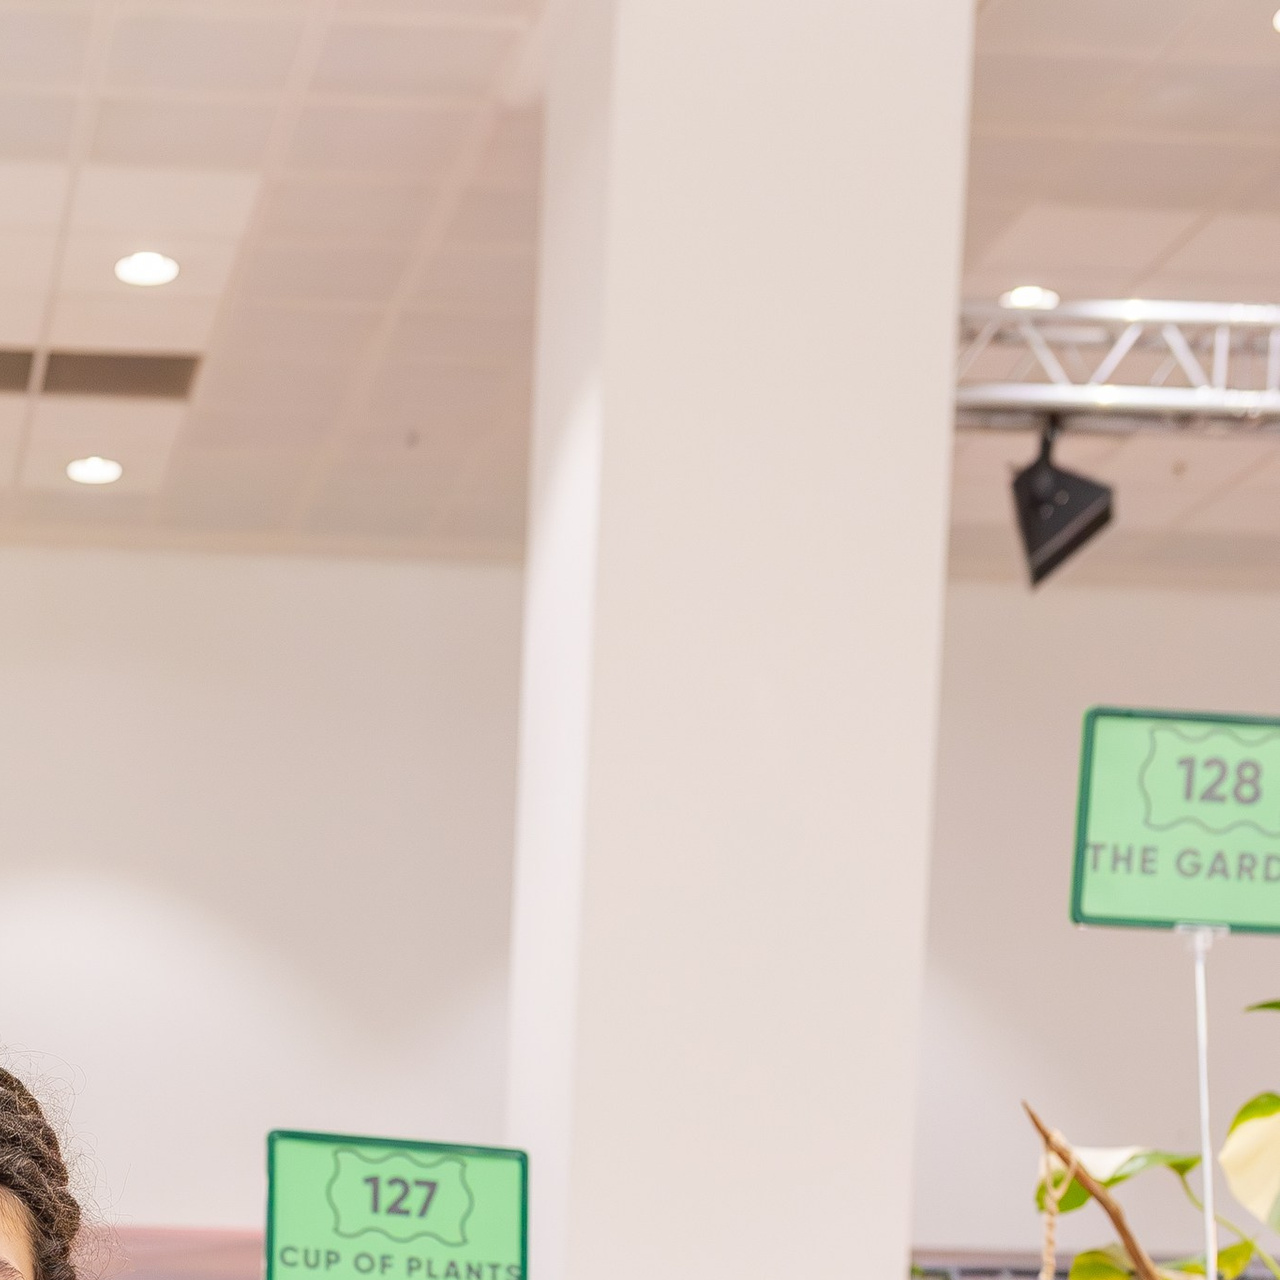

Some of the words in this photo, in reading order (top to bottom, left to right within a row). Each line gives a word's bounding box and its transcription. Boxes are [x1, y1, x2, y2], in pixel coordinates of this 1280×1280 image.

[1177, 756, 1263, 805] 128
[1087, 842, 1159, 875] THE
[363, 1175, 440, 1219] 127
[279, 1245, 341, 1271] CUP
[353, 1251, 394, 1276] OF
